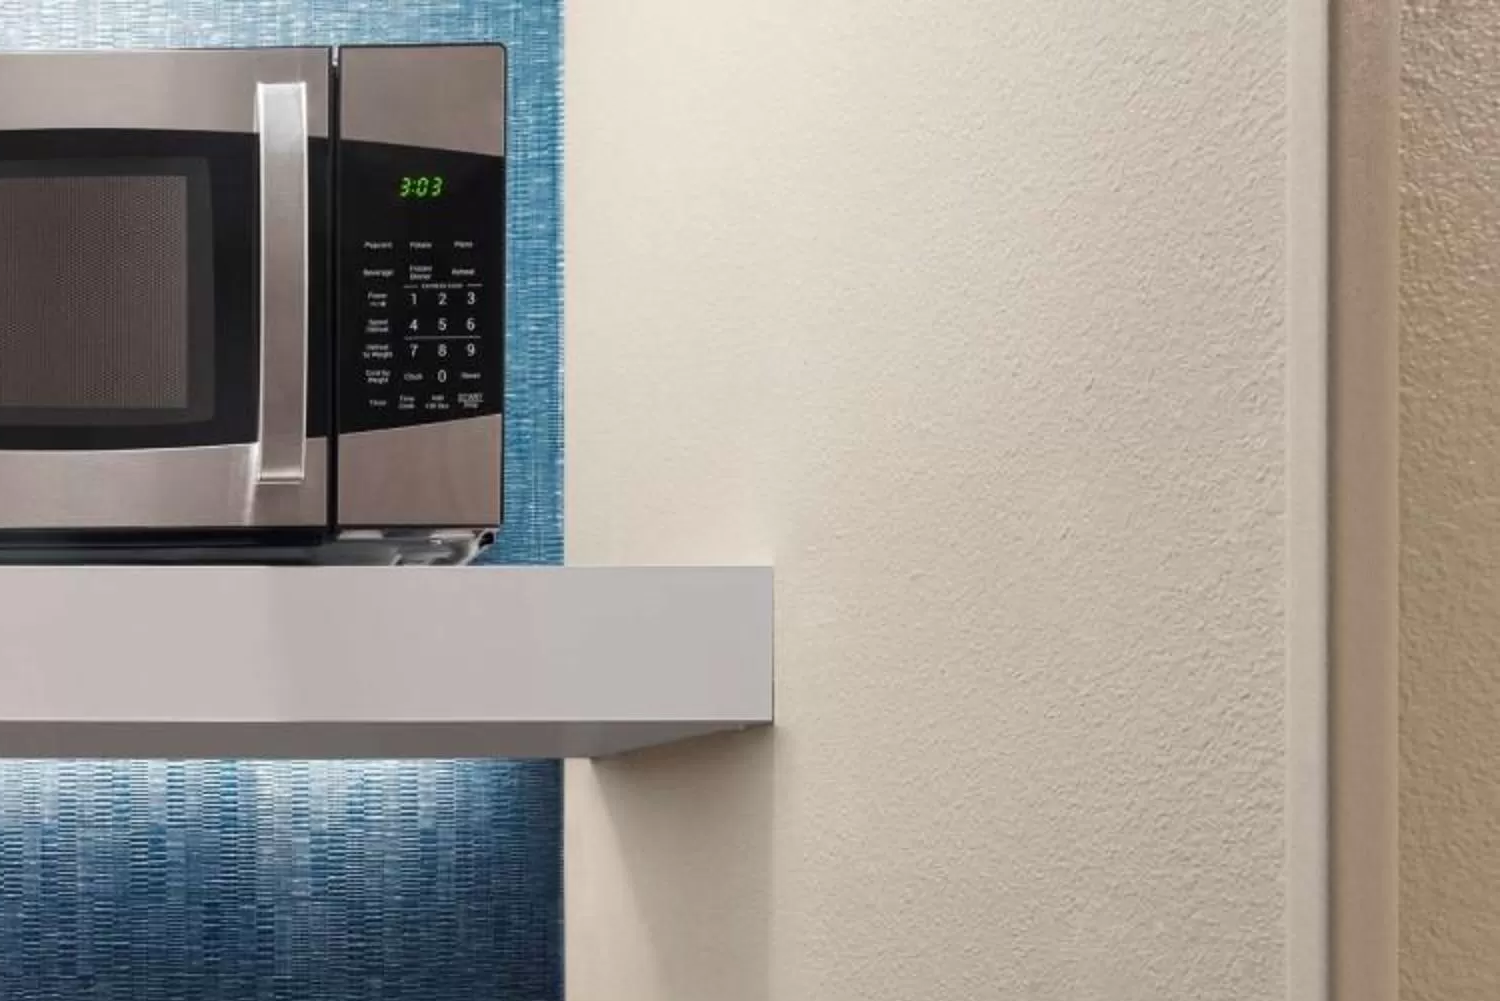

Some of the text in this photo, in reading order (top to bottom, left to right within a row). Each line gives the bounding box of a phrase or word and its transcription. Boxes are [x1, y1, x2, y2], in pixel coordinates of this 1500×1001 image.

[400, 176, 443, 197] 3:03
[410, 291, 476, 305] 1 2 3
[409, 317, 476, 331] 4 5 6
[409, 343, 476, 358] 7 8 9
[438, 369, 447, 383] 0
